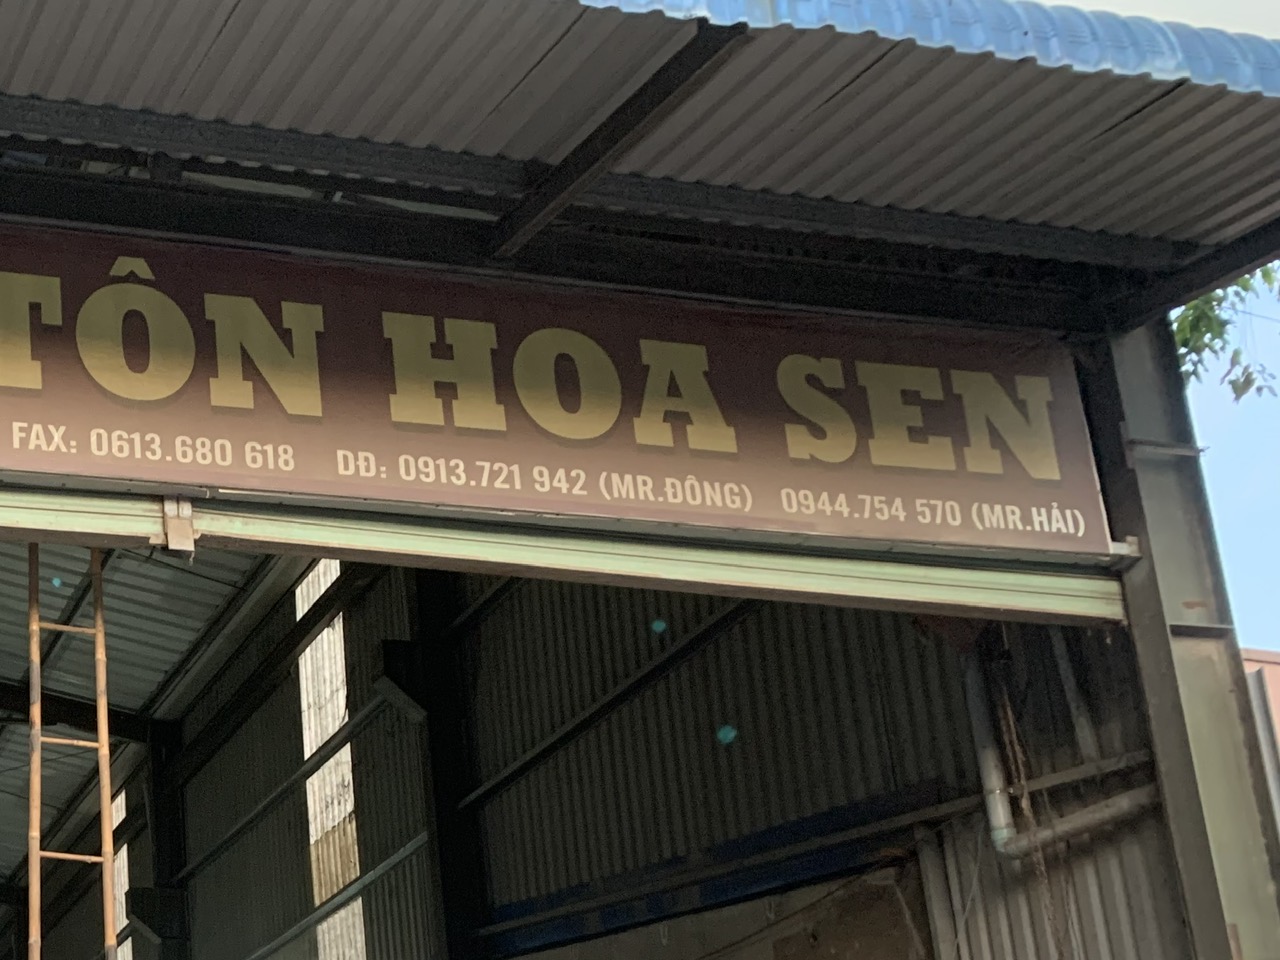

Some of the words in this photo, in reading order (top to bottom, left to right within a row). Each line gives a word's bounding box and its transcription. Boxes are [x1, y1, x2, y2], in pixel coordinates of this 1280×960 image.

[381, 312, 739, 453] HOA
[776, 354, 1062, 480] SEN
[12, 422, 77, 453] FAX:
[90, 428, 233, 466] 0613.680
[244, 441, 295, 471] 618
[337, 449, 387, 478] DĐ:
[398, 454, 521, 489] 0913.721
[533, 465, 588, 495] 942
[599, 471, 752, 511] (MR.ĐÔNG)
[780, 487, 907, 522] 0944.754
[915, 498, 962, 526] 570
[971, 501, 1086, 537] (MR.HẢI)
